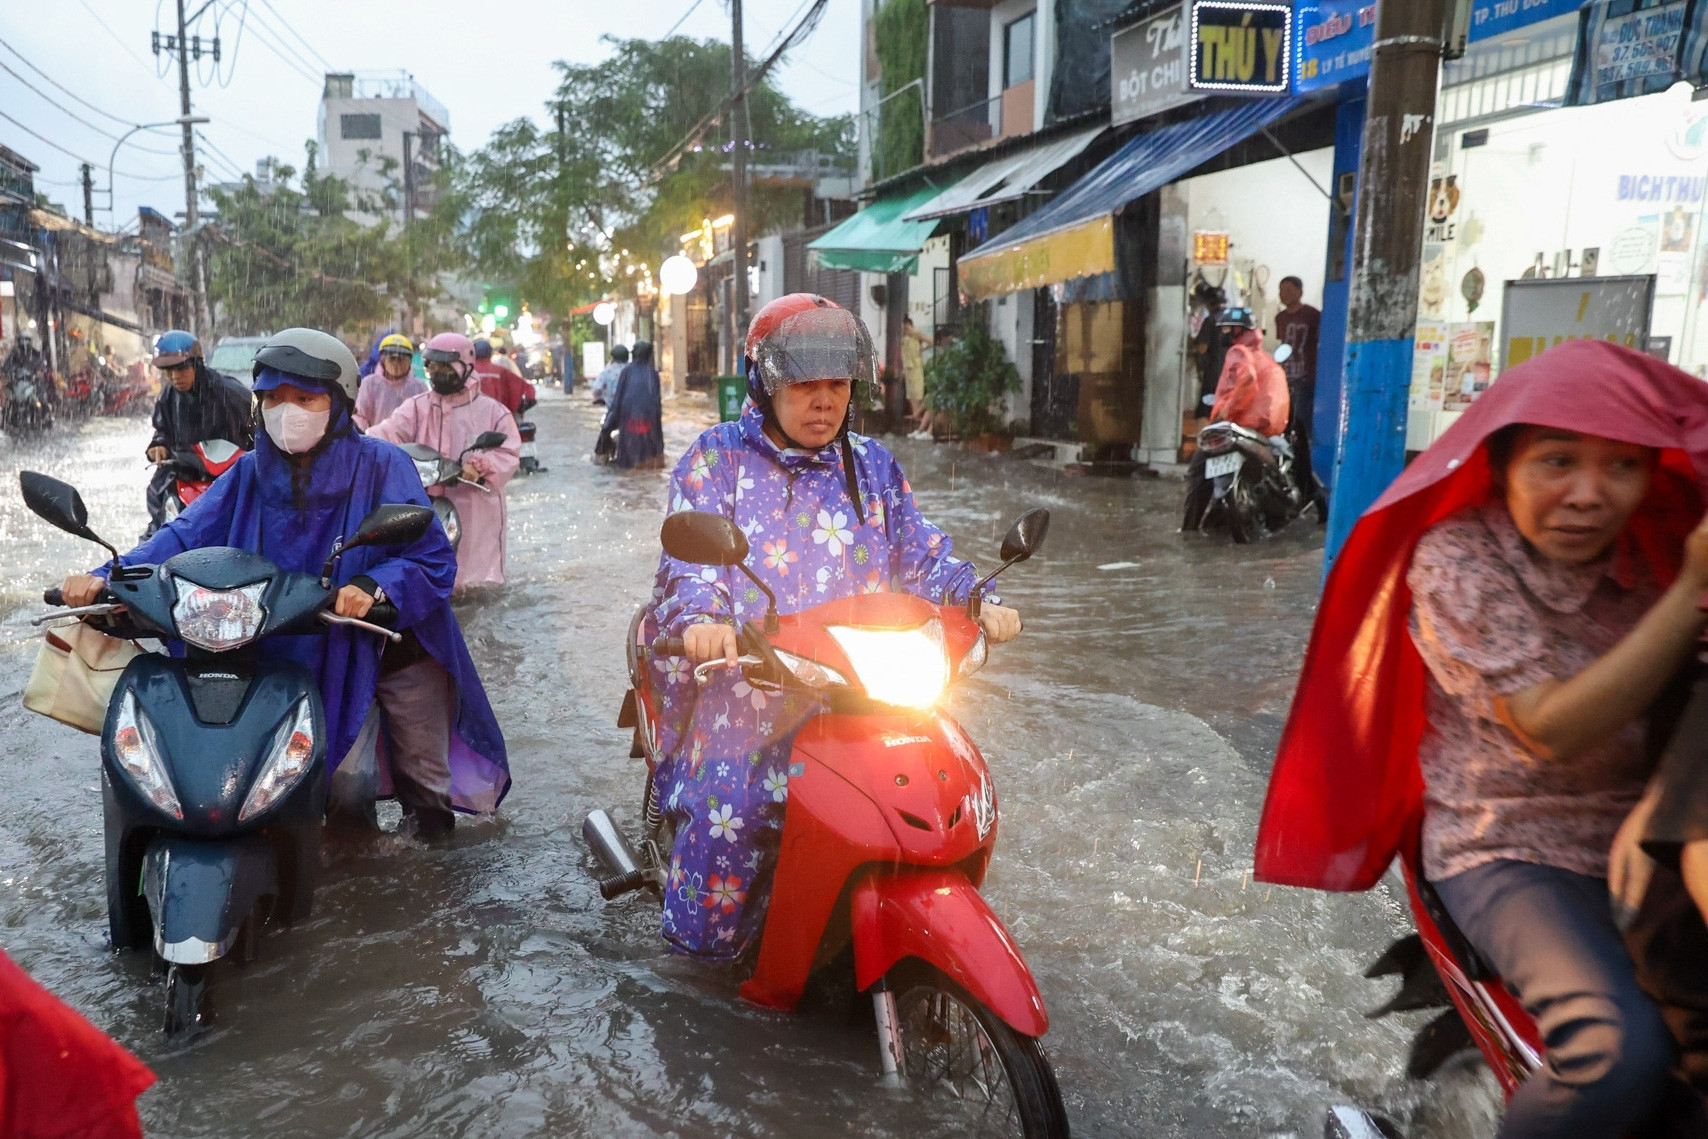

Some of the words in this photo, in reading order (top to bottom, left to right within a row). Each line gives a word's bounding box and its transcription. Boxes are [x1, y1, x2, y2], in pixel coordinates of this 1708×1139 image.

[1199, 12, 1257, 82] THÚ
[1262, 28, 1283, 82] Y
[198, 672, 239, 680] HONDA
[884, 736, 932, 747] HONDA
